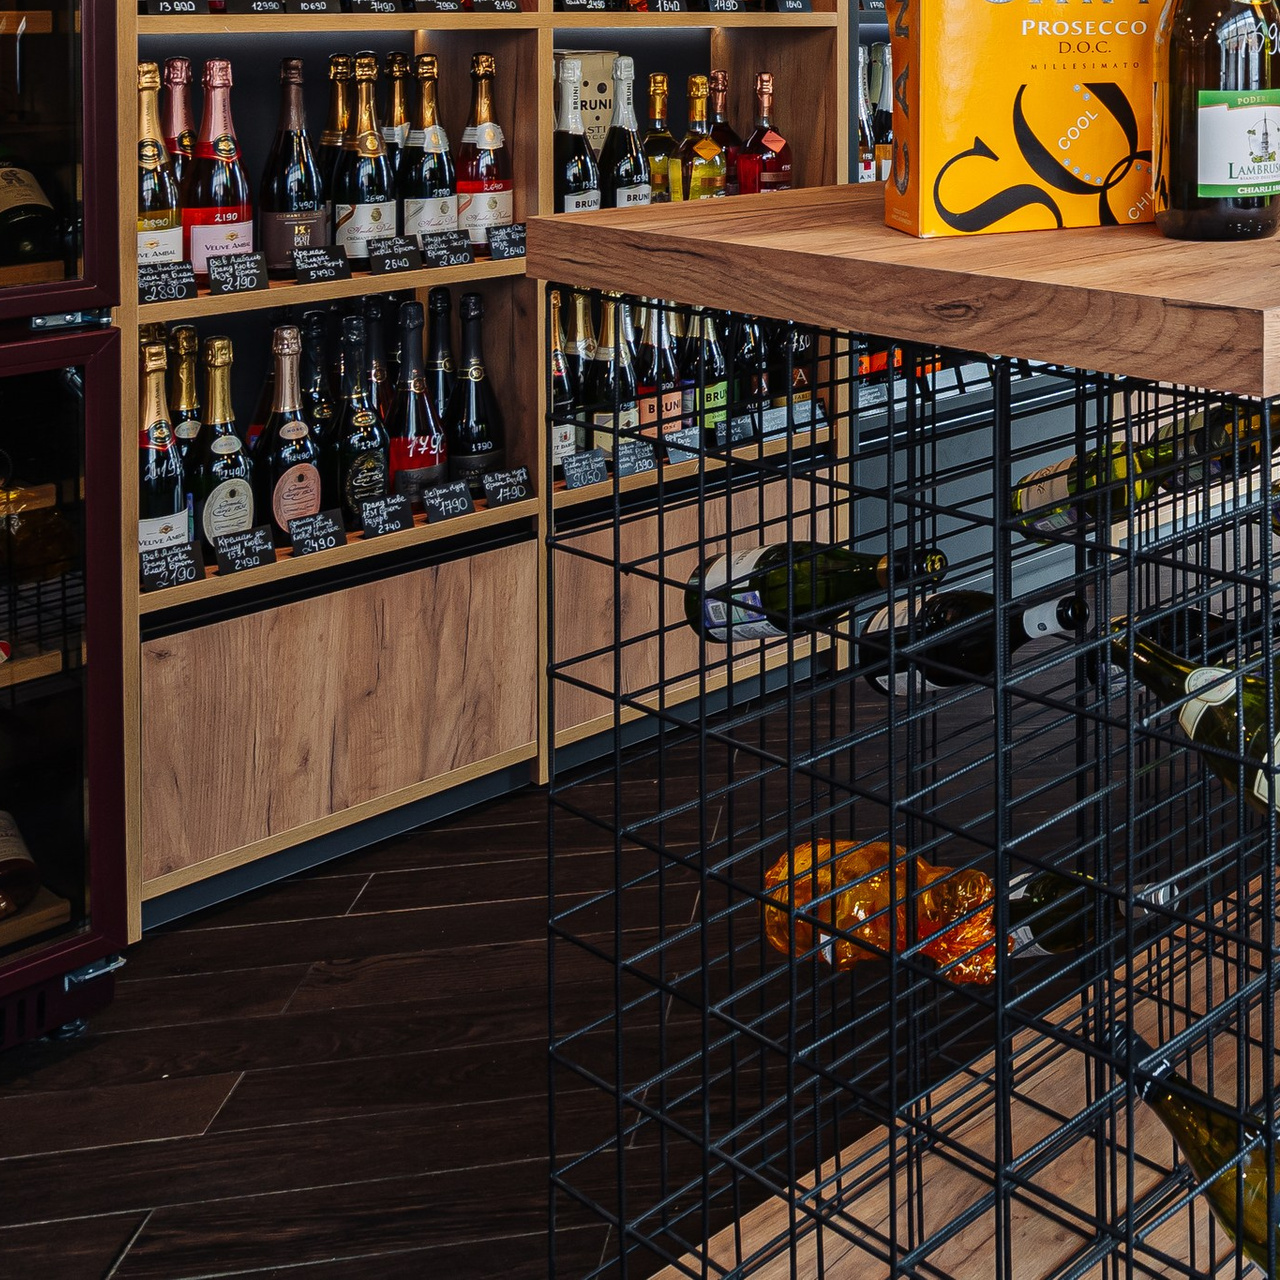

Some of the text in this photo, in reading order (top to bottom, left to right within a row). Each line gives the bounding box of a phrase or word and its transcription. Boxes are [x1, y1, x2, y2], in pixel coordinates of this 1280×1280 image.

[300, 2, 326, 10] 10690
[1021, 19, 1148, 37] PROSECCO
[1057, 39, 1112, 55] D.O.C.
[1030, 61, 1141, 71] MILLESIMATO
[1057, 108, 1100, 151] COOL
[1237, 186, 1272, 194] CHIARLI
[214, 213, 238, 222] 2190
[152, 249, 175, 257] AMBAL
[439, 252, 470, 266] 2890
[385, 258, 409, 270] 2640
[221, 276, 257, 292] 2190
[145, 285, 186, 302] 2890
[471, 442, 493, 452] 1790
[496, 485, 526, 502] 1790
[439, 498, 468, 516] 1790
[302, 536, 336, 553] 2490
[234, 556, 260, 570] 2490
